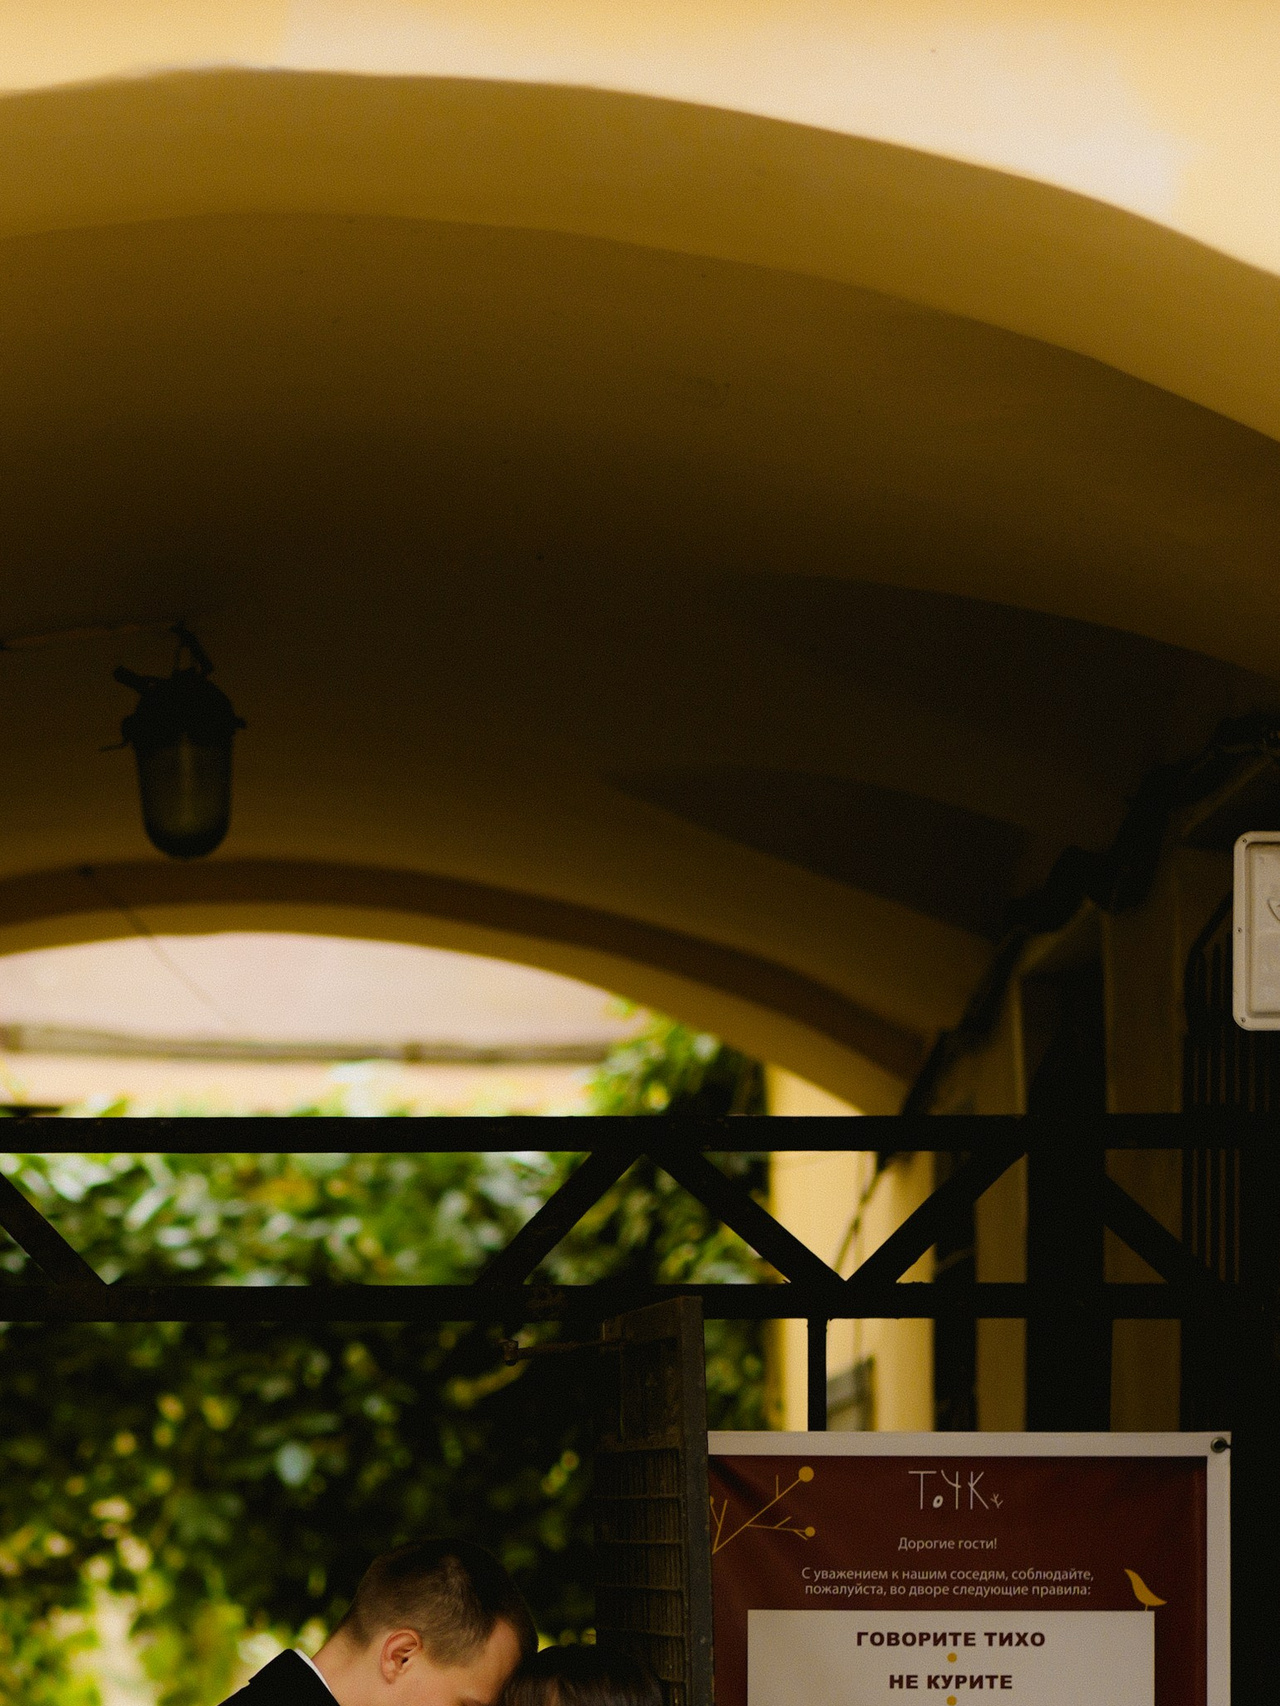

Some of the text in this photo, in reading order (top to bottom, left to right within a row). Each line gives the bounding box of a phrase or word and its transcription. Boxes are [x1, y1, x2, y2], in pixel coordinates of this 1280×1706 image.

[898, 1537, 997, 1552] Дорогие гости!
[801, 1567, 1093, 1583] С уважением к нашим соседям, соблюдайте,
[805, 1583, 1090, 1598] пожалуйста, во дворе следующие правила:
[857, 1632, 1045, 1647] ГОВОРИТЕ ТИХО
[889, 1674, 1012, 1689] НЕ КУРИТЕ
